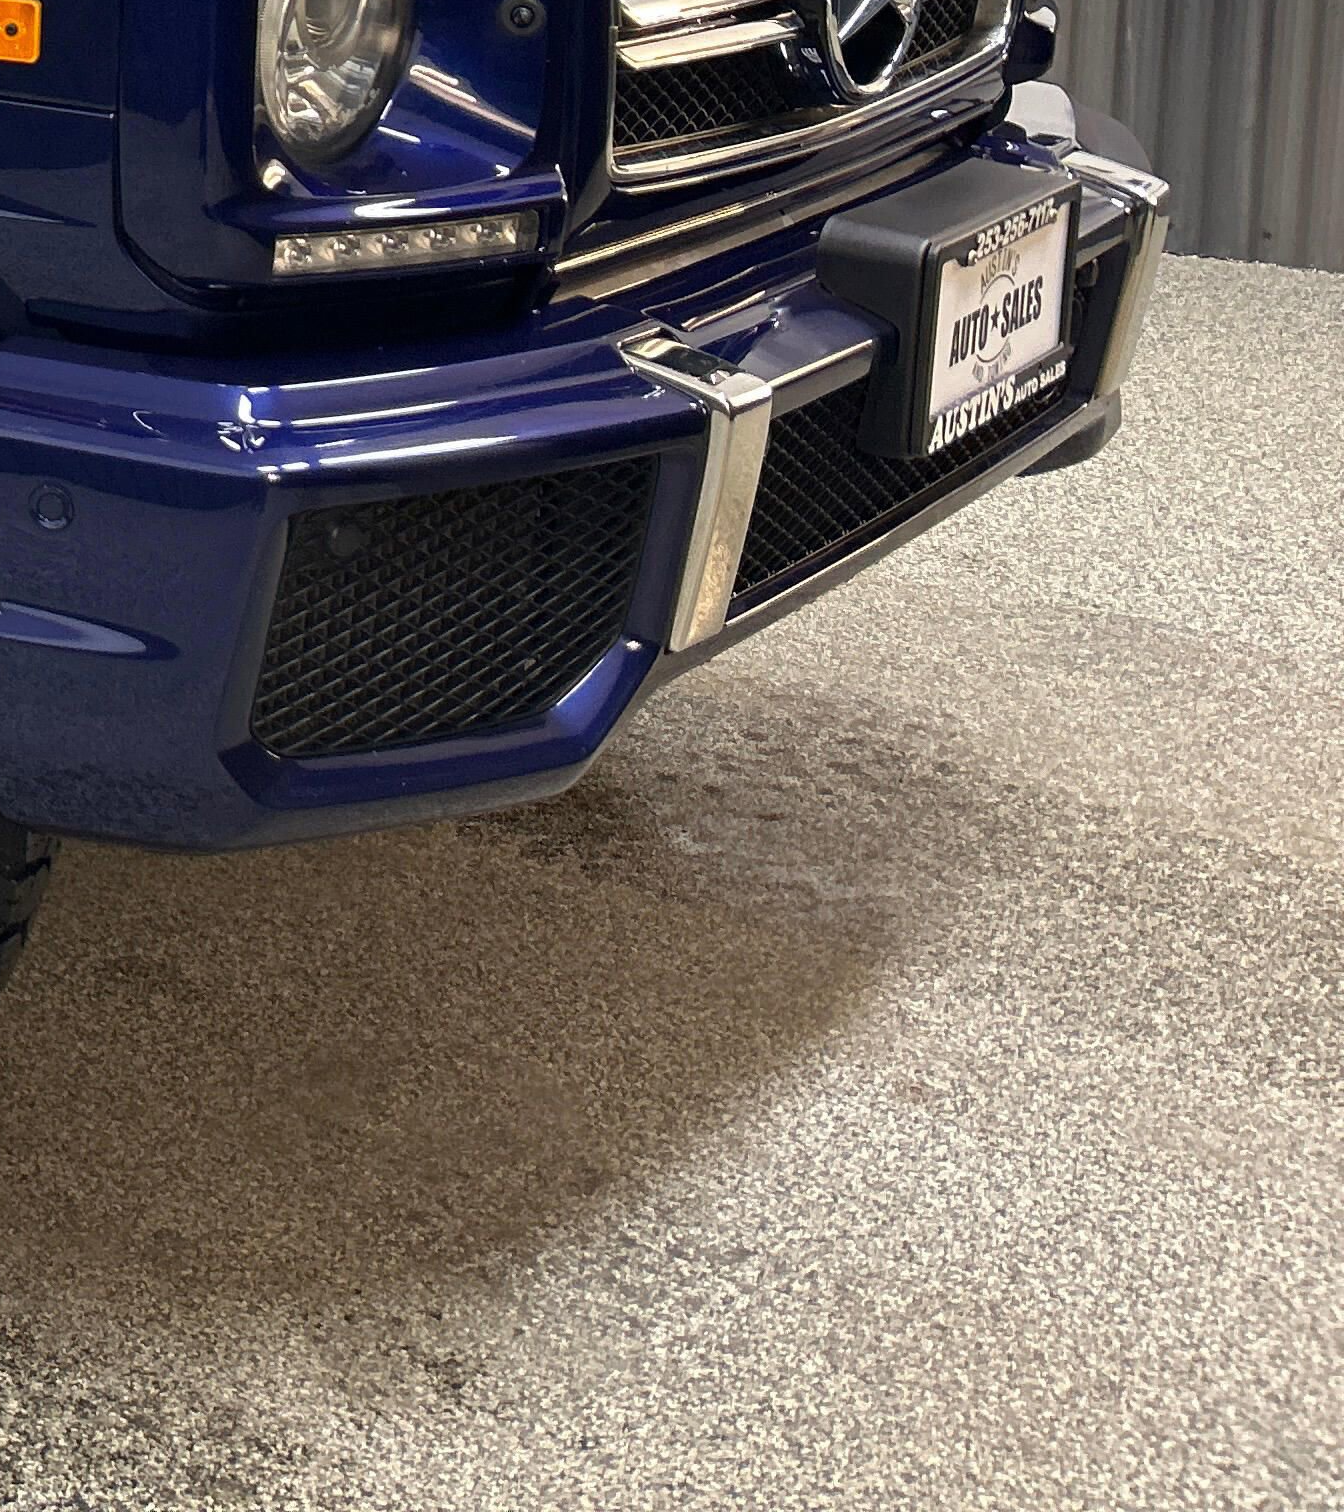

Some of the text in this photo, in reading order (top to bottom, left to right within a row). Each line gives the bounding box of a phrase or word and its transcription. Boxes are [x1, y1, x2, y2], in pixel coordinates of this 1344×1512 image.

[980, 246, 1020, 295] AUSTIN'S
[949, 304, 989, 368] AUTO
[1001, 275, 1043, 338] SALES
[928, 374, 1016, 455] AUSTIN'S
[1014, 377, 1039, 405] AUTO
[1039, 359, 1067, 389] SALES
